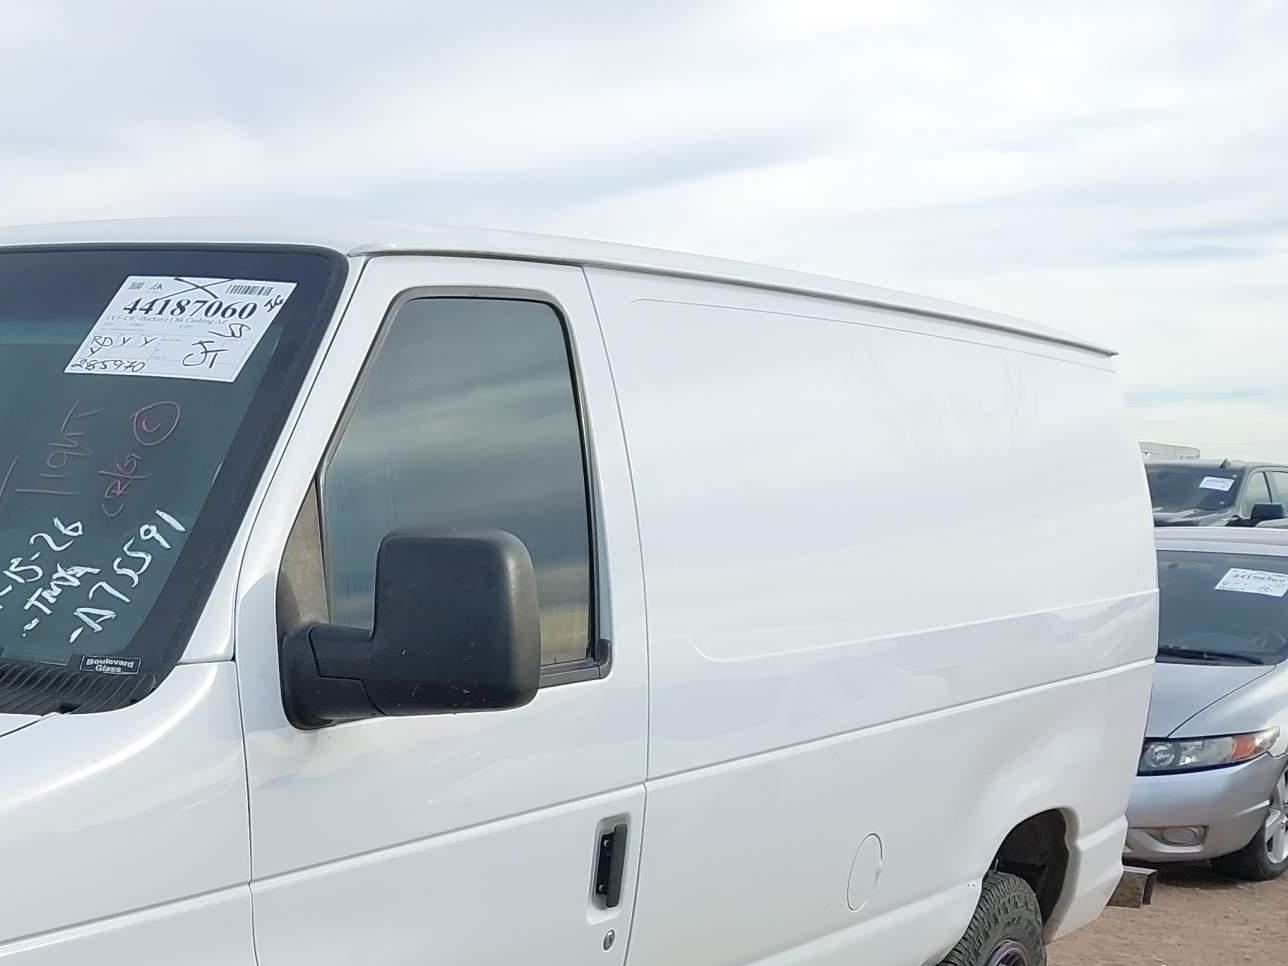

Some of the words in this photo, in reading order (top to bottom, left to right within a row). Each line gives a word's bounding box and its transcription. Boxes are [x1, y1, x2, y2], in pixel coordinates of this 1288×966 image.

[123, 297, 258, 320] 44187060
[86, 658, 135, 669] Boulevard
[95, 664, 122, 673] Glass
